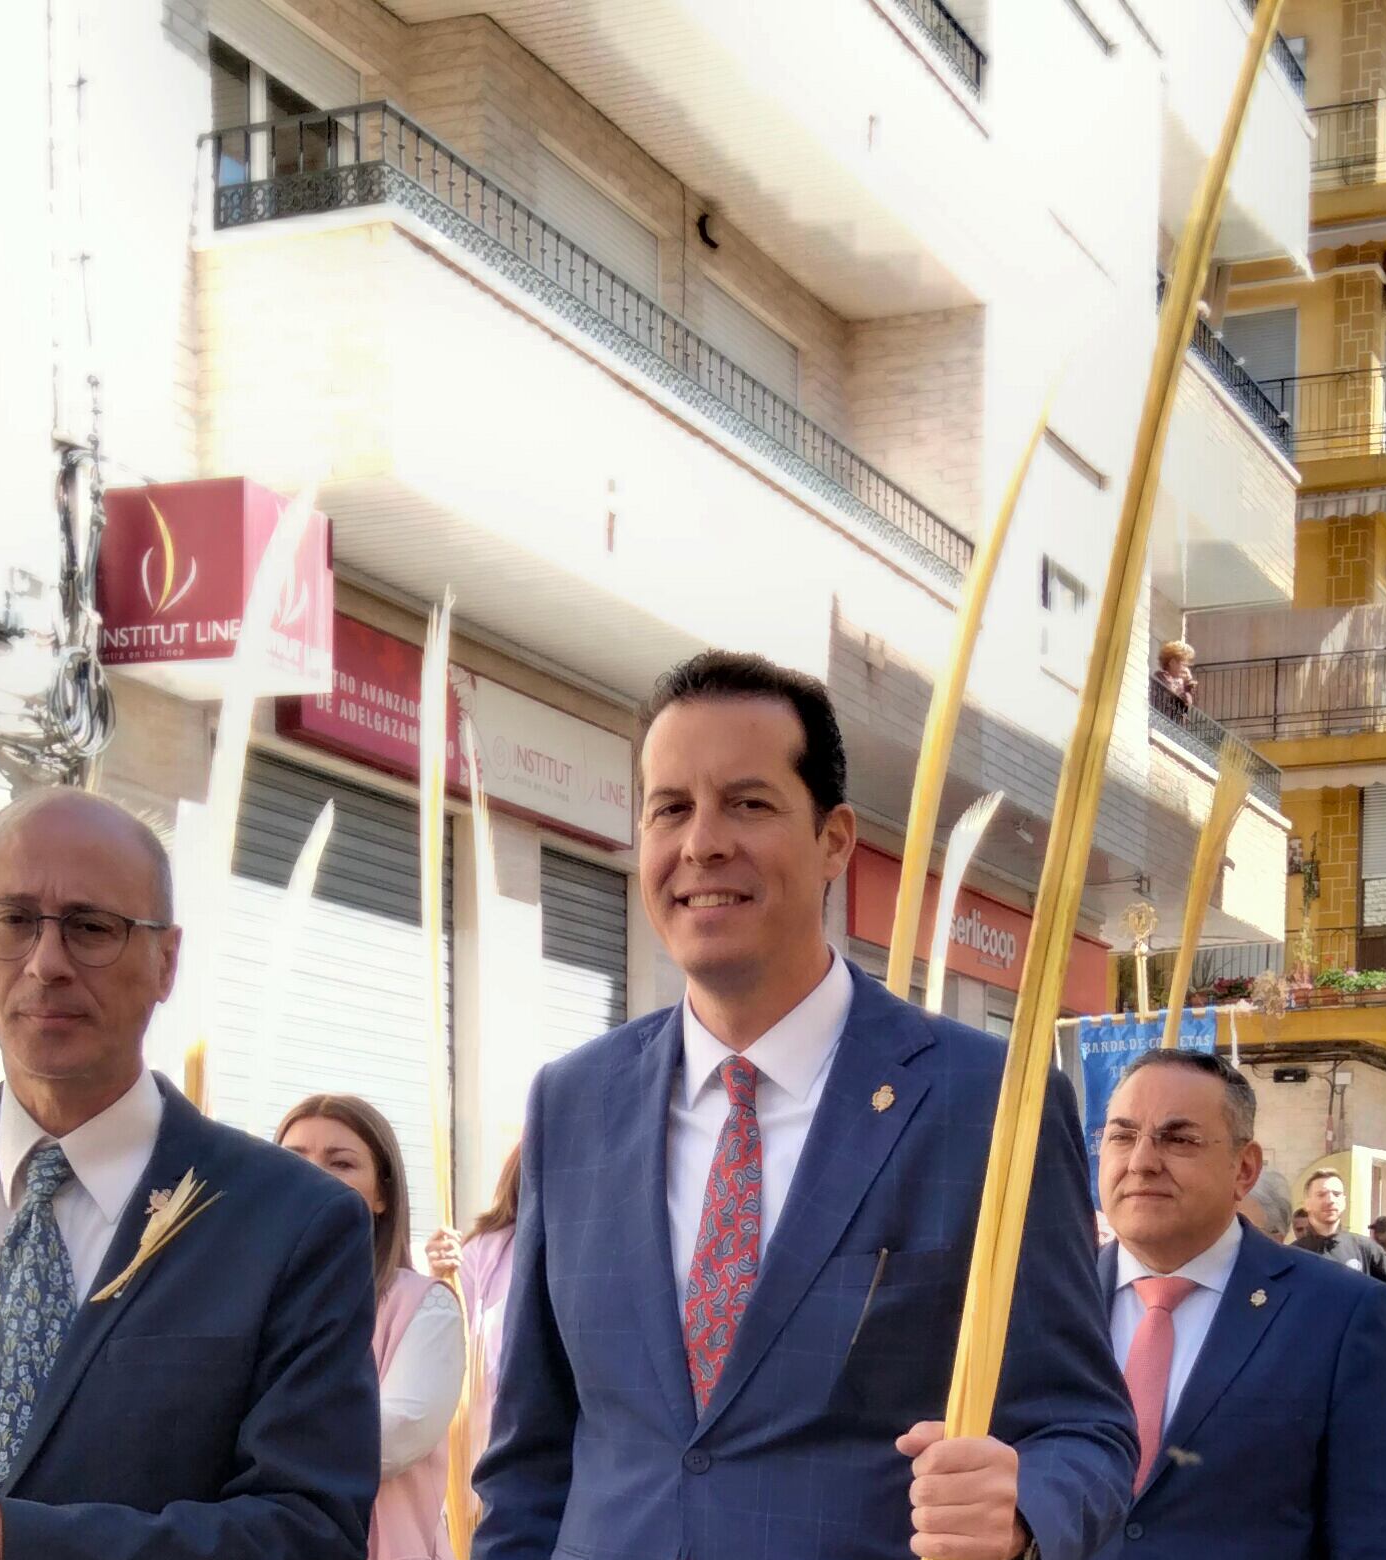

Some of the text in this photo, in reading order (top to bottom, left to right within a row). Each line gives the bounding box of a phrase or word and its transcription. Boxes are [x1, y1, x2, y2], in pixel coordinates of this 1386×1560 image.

[99, 619, 242, 648] INSTITUT LINE
[332, 669, 355, 695] TRO
[316, 693, 333, 713] DE
[599, 777, 626, 808] LINE
[1082, 1034, 1211, 1053] BANDA DE COETAS
